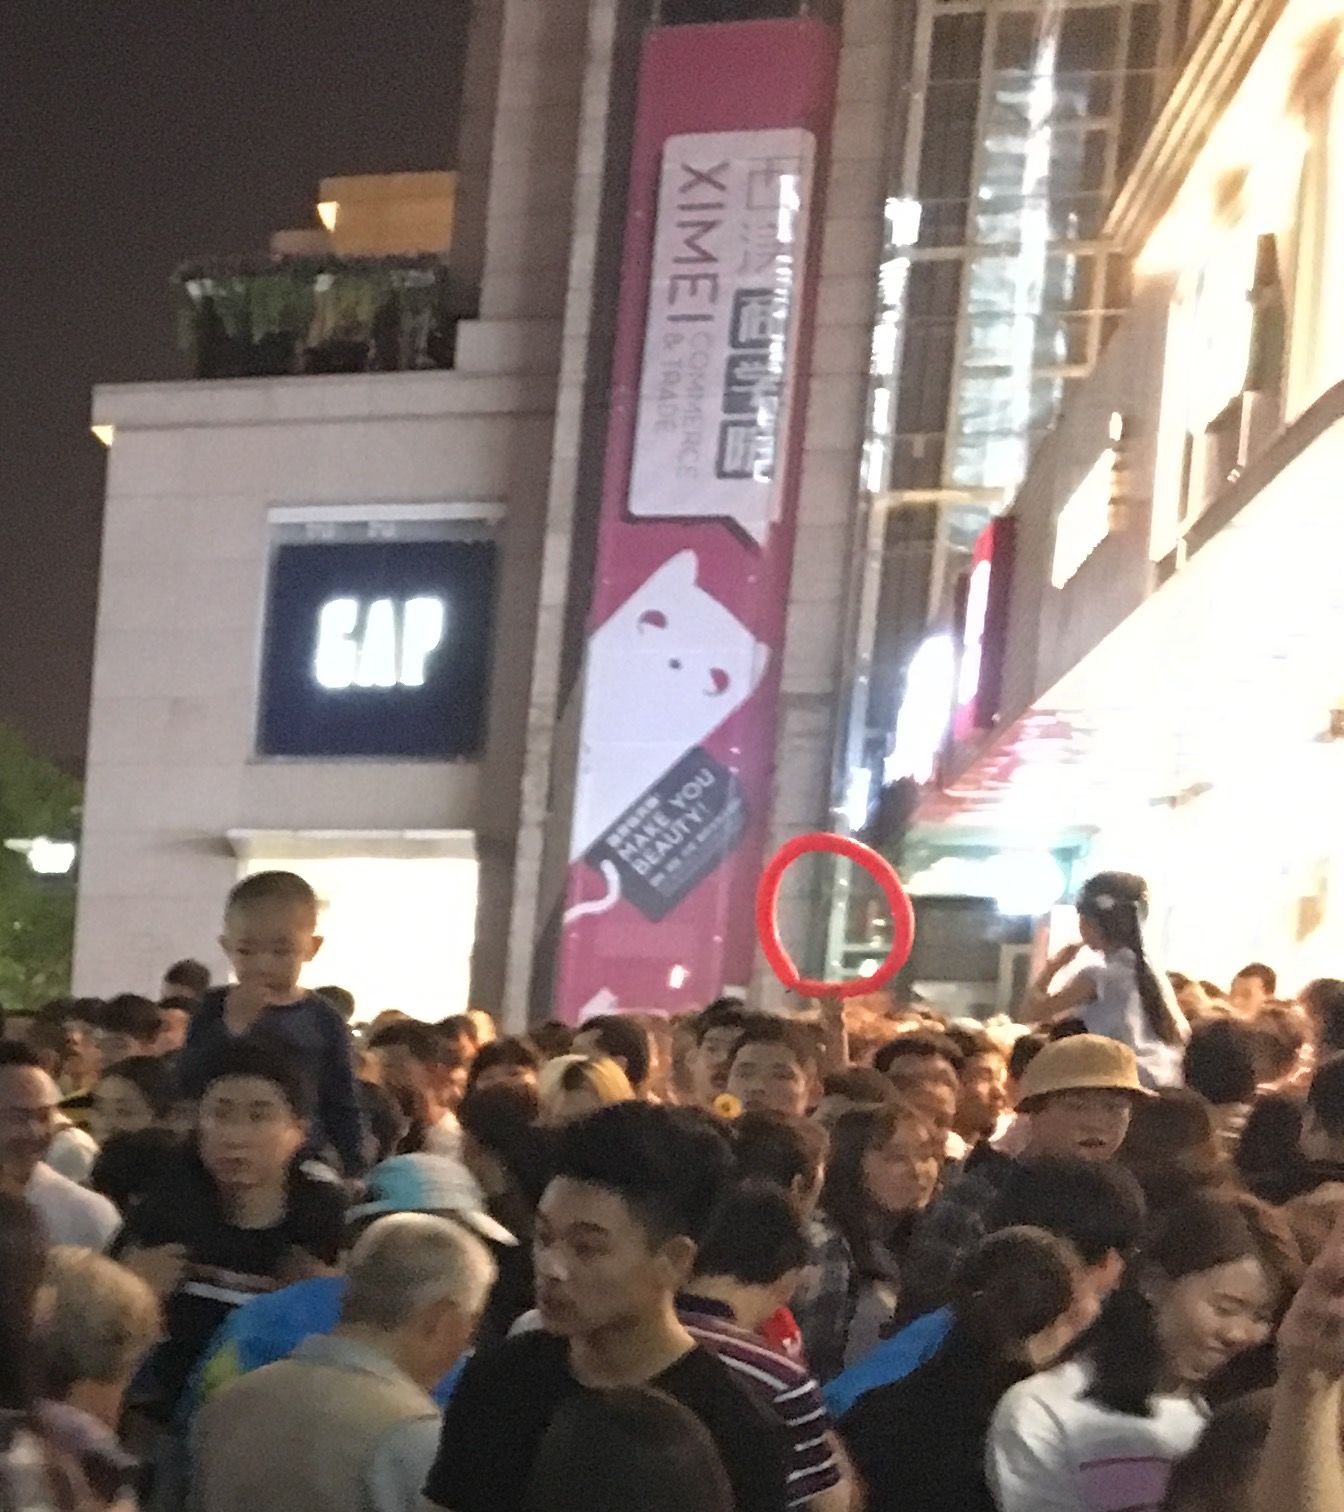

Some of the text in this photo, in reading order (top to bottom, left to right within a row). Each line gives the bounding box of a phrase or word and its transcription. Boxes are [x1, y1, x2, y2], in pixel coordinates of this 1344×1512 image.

[666, 159, 730, 322] XIMEI
[654, 359, 683, 434] TRADE
[676, 329, 711, 480] COMMERCE
[315, 597, 444, 688] GAP
[617, 811, 671, 863] MAKE
[668, 768, 716, 809] YOU
[631, 801, 710, 876] BEAUTY!
